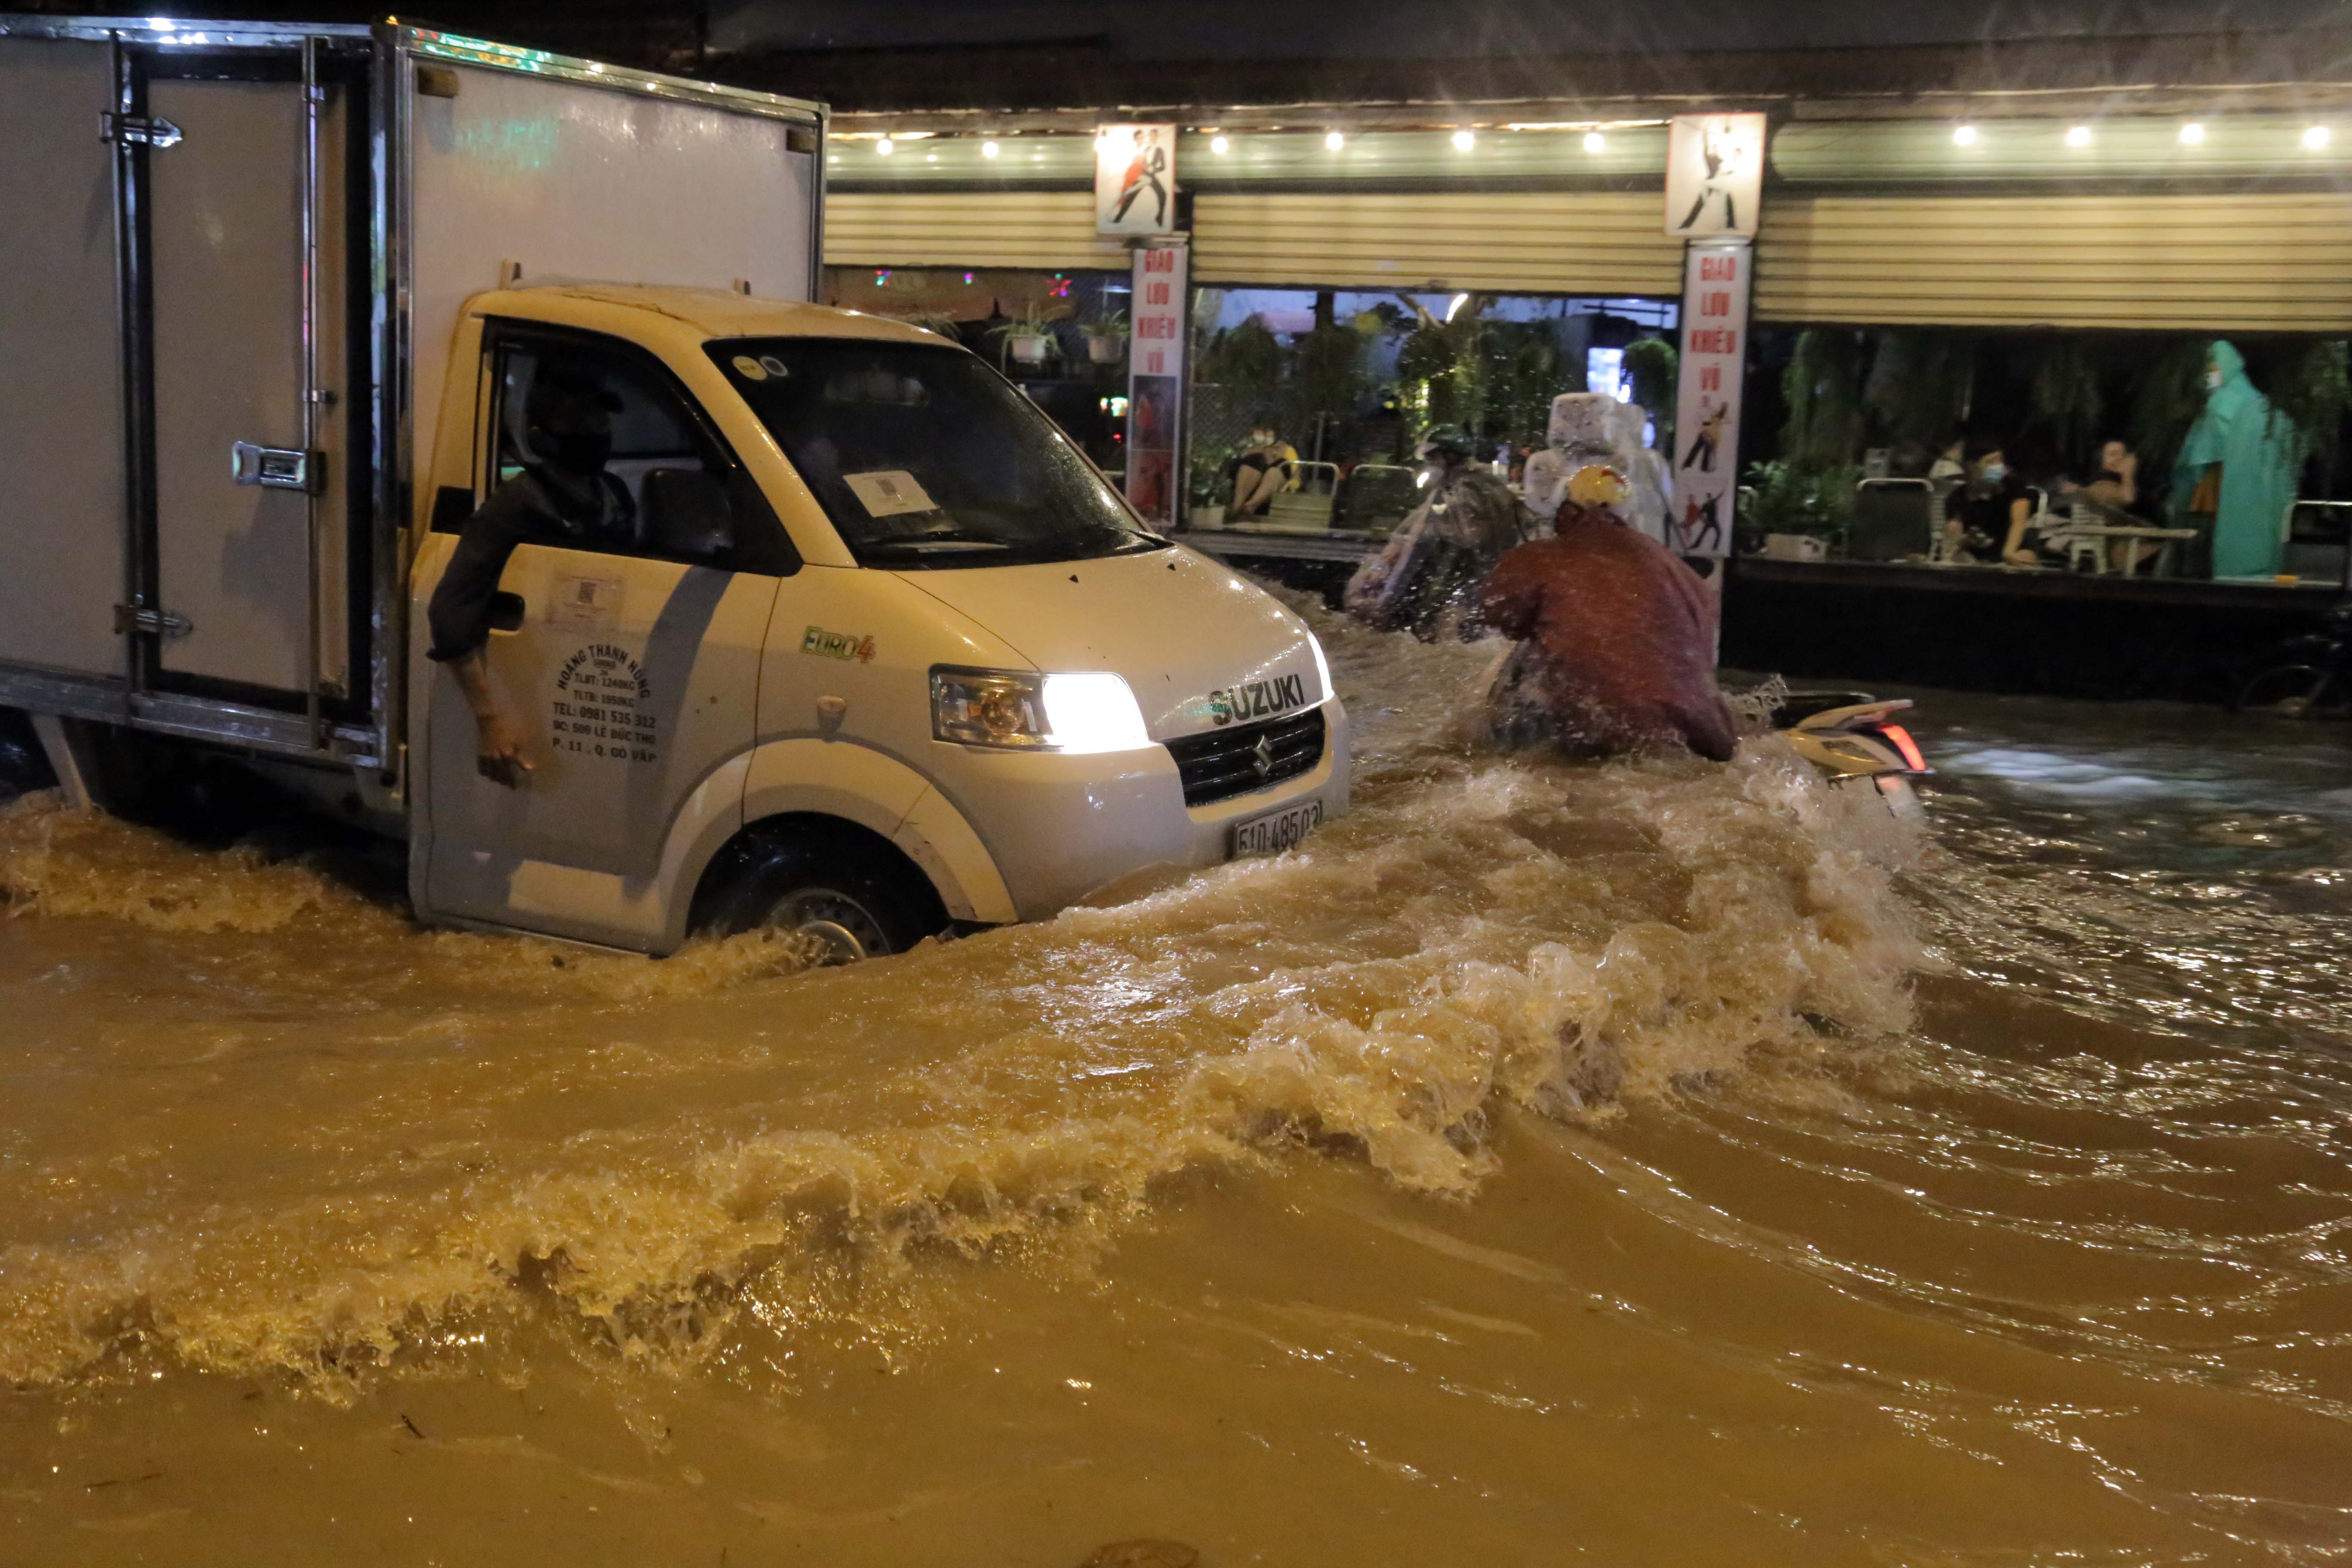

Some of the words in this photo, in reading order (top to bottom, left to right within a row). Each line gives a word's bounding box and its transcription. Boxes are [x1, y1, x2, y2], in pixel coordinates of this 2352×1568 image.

[1701, 257, 1736, 281] GIAO
[1208, 674, 1305, 726] SUZUKI
[611, 710, 631, 725] 535
[635, 715, 656, 729] 312
